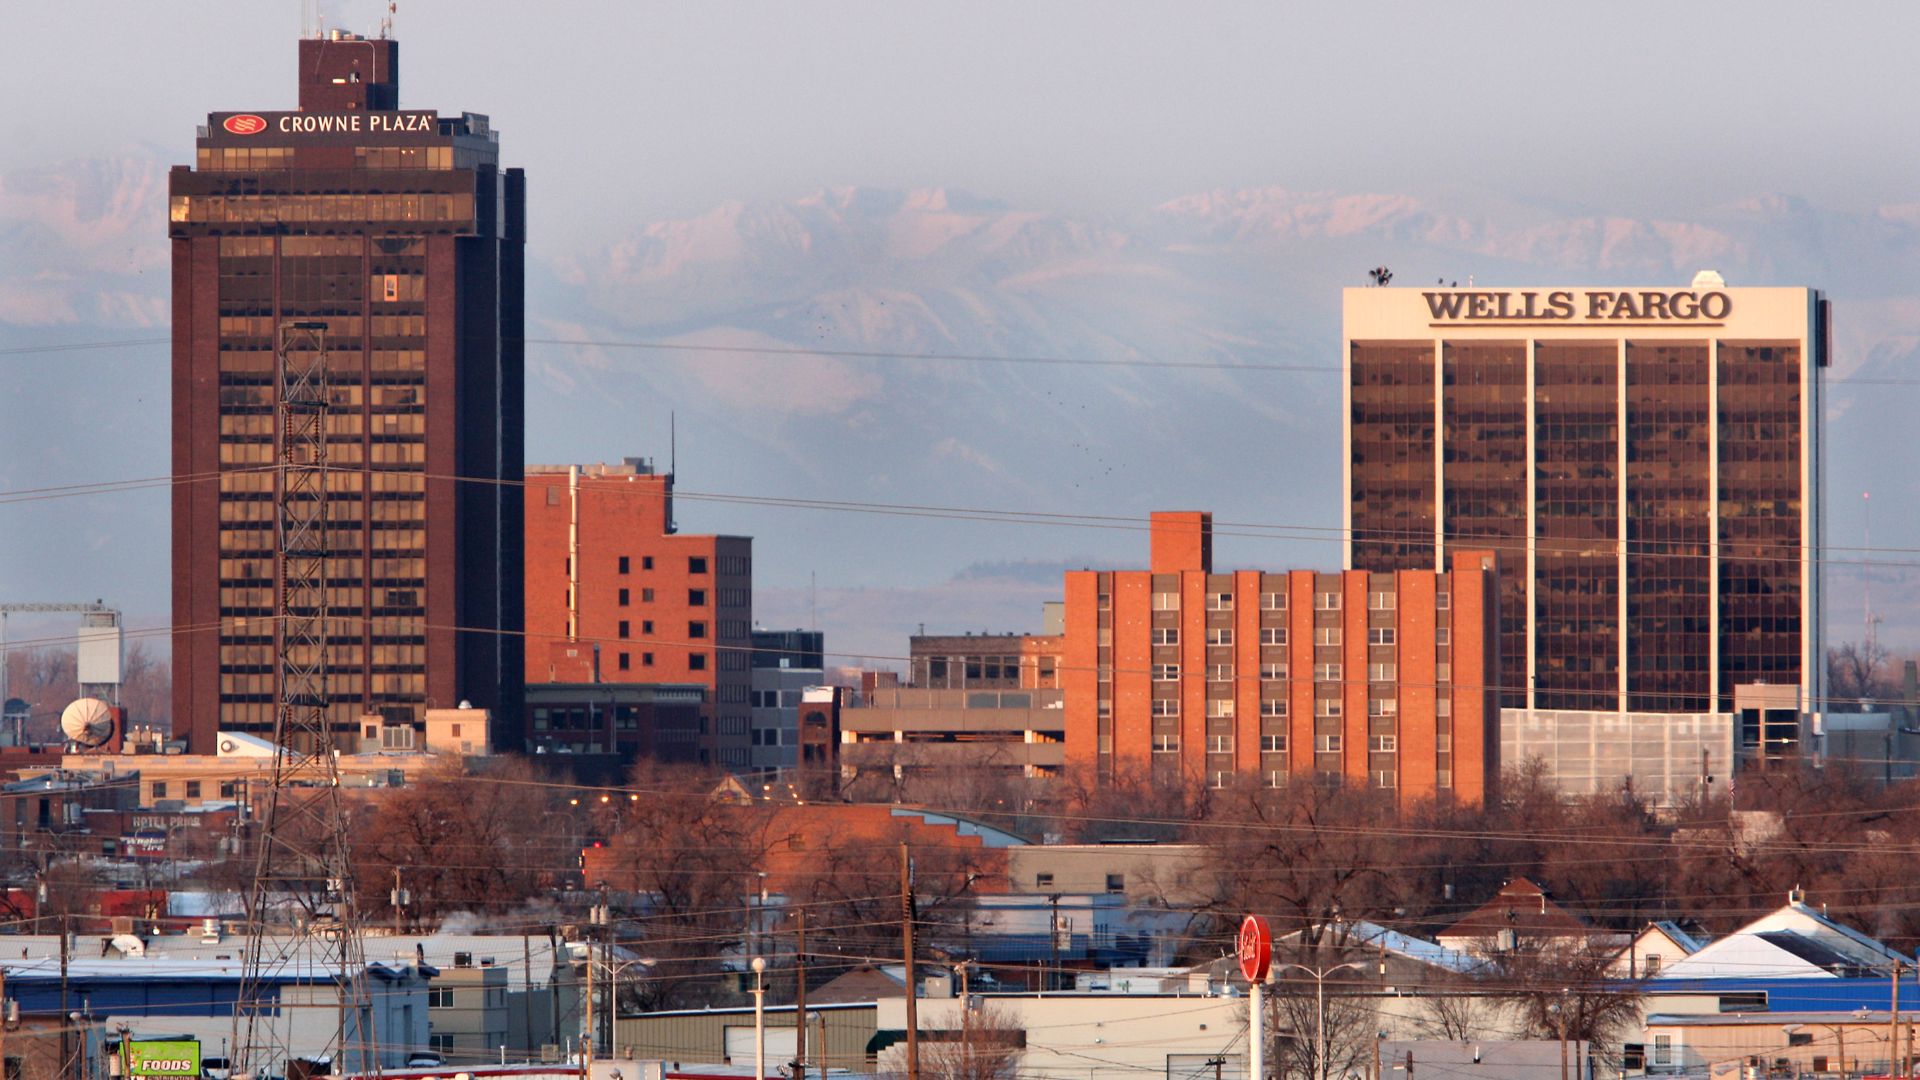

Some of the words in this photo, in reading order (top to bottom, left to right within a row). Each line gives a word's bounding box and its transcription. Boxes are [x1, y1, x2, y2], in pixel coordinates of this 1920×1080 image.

[279, 116, 360, 132] CROWNE
[370, 115, 431, 131] PLAZA
[1422, 291, 1575, 320] WELLS
[1584, 291, 1732, 320] FARGO
[142, 1060, 191, 1071] FOODS
